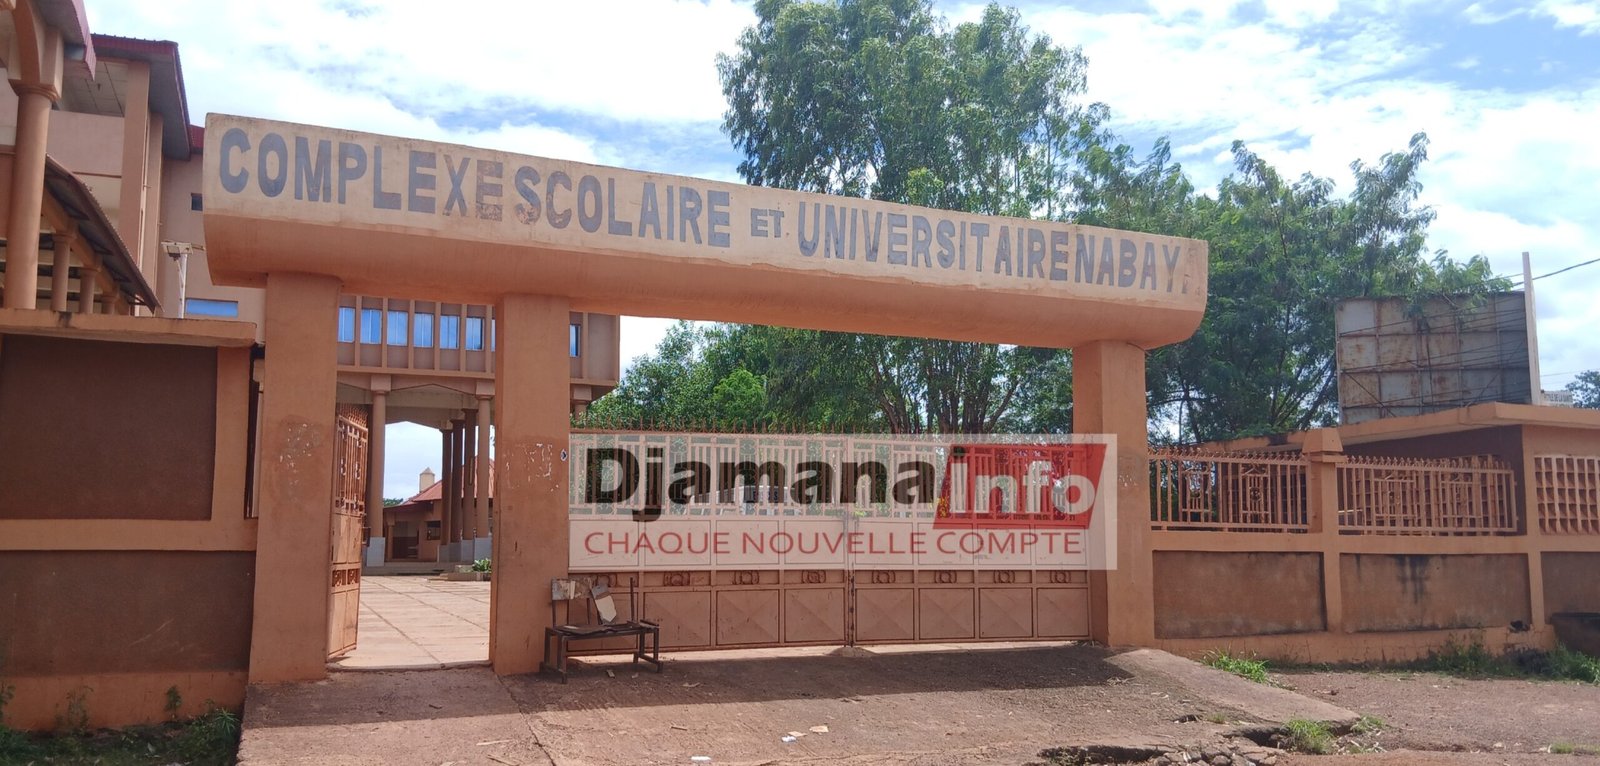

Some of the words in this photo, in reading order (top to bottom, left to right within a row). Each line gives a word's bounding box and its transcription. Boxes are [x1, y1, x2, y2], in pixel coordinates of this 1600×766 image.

[219, 128, 503, 222] COMPLEXE
[514, 166, 731, 248] SCOLAIRE
[751, 208, 785, 239] ET
[798, 201, 1068, 282] UNIVERSITAIRE
[1075, 233, 1202, 295] NABAY
